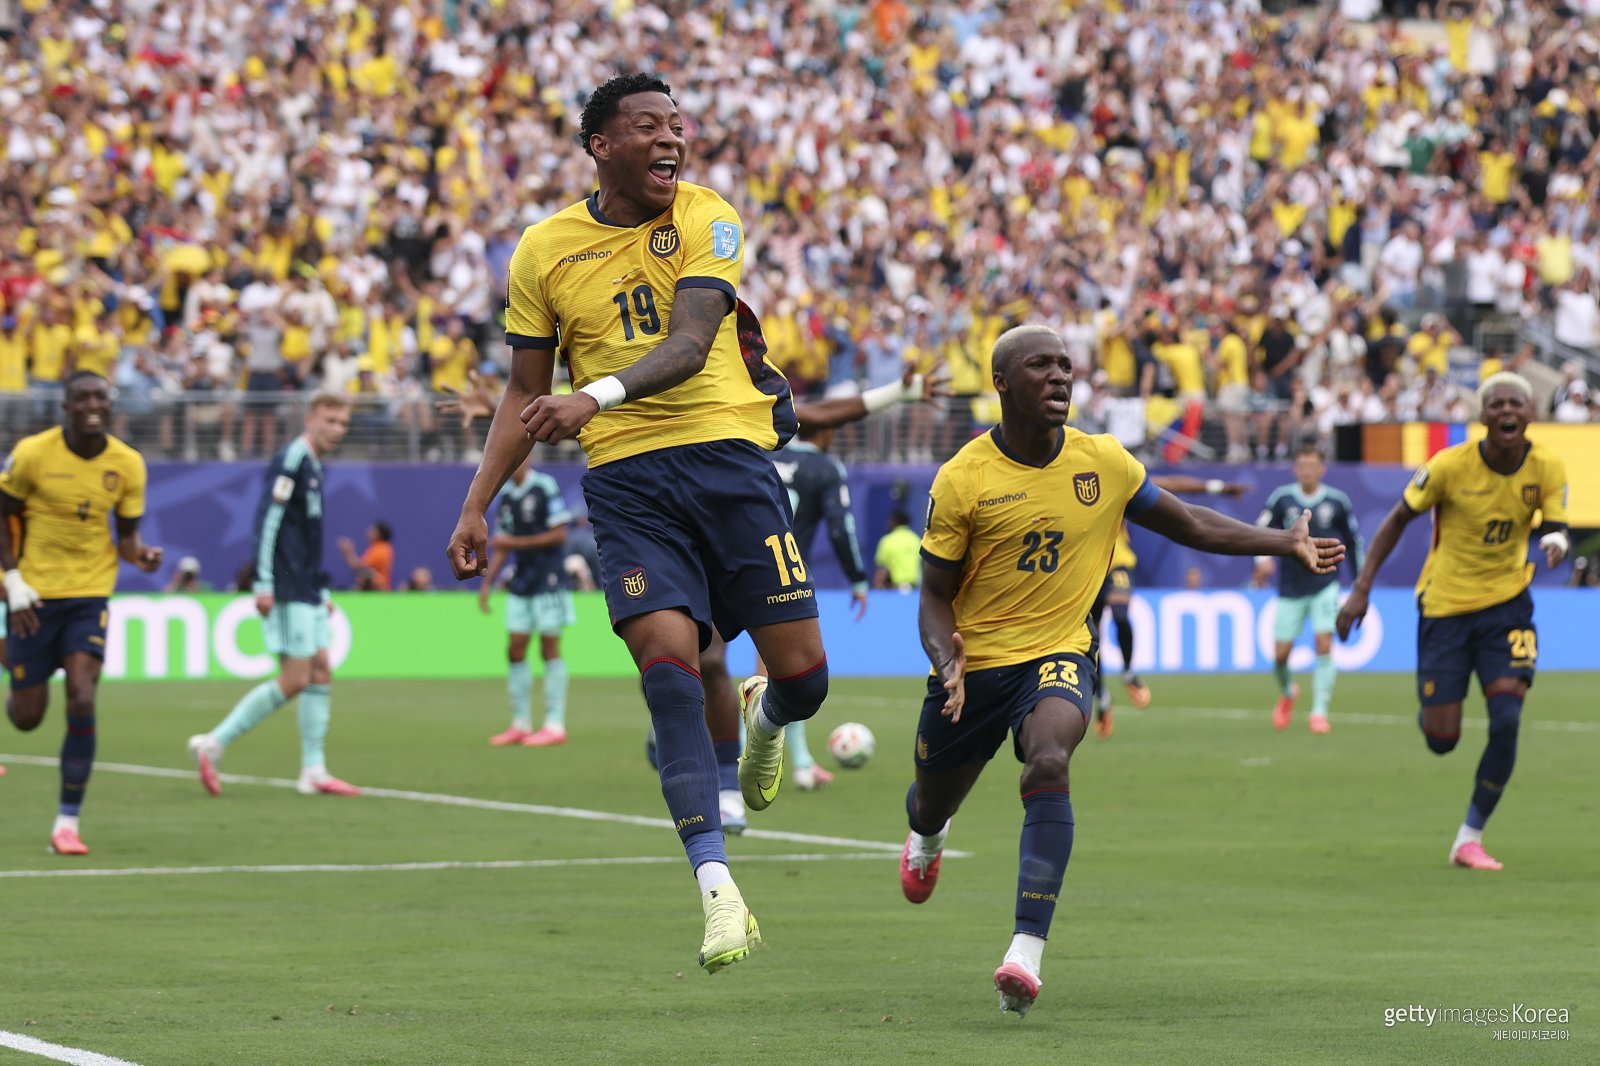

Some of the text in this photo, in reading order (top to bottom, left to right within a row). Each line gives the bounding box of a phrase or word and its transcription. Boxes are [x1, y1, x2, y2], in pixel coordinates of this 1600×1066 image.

[559, 249, 613, 268] marathon
[612, 284, 661, 341] 19
[978, 491, 1028, 508] marathon
[1484, 519, 1513, 544] 20
[764, 531, 807, 587] 19
[1016, 530, 1064, 573] 23
[767, 588, 813, 604] marathon
[1038, 661, 1079, 686] 23
[1038, 681, 1083, 699] marathon
